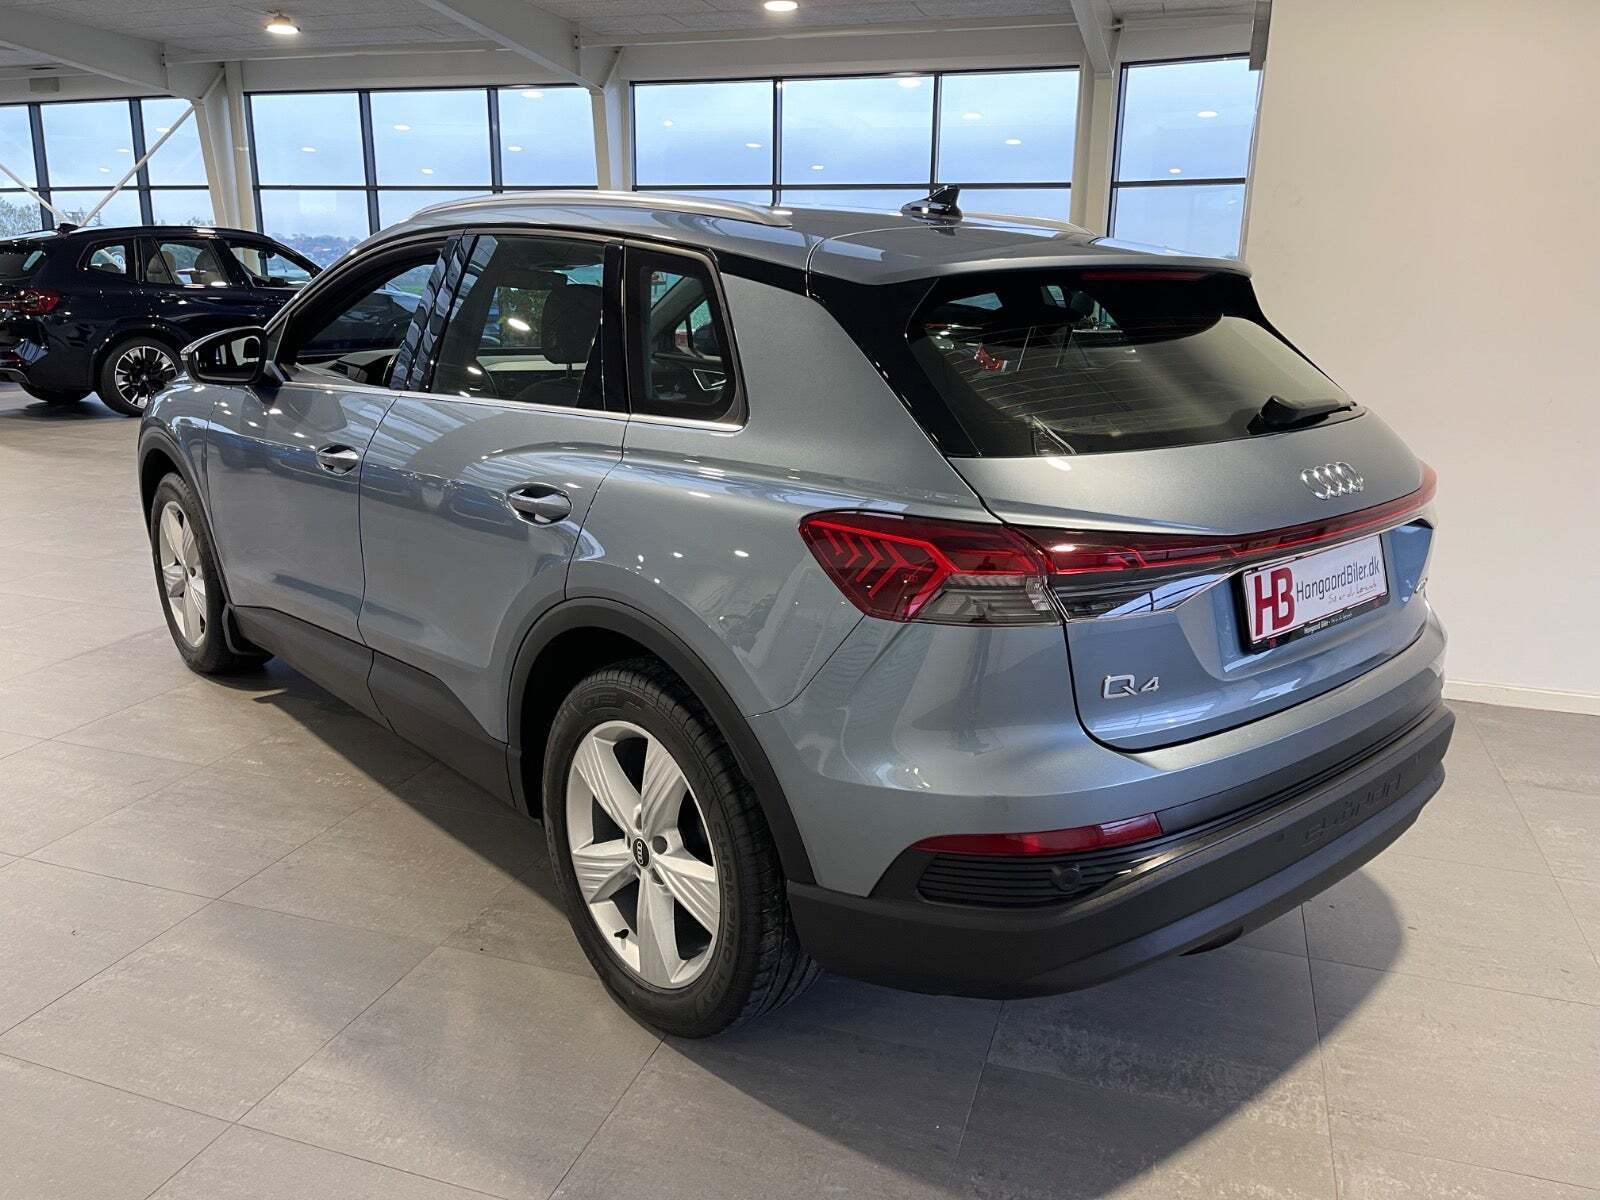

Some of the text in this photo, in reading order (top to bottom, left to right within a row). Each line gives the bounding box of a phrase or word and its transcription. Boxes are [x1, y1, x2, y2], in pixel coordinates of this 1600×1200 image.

[1254, 567, 1295, 637] HB
[1296, 556, 1380, 602] HangaardBiler.dk
[1102, 674, 1159, 700] Q4
